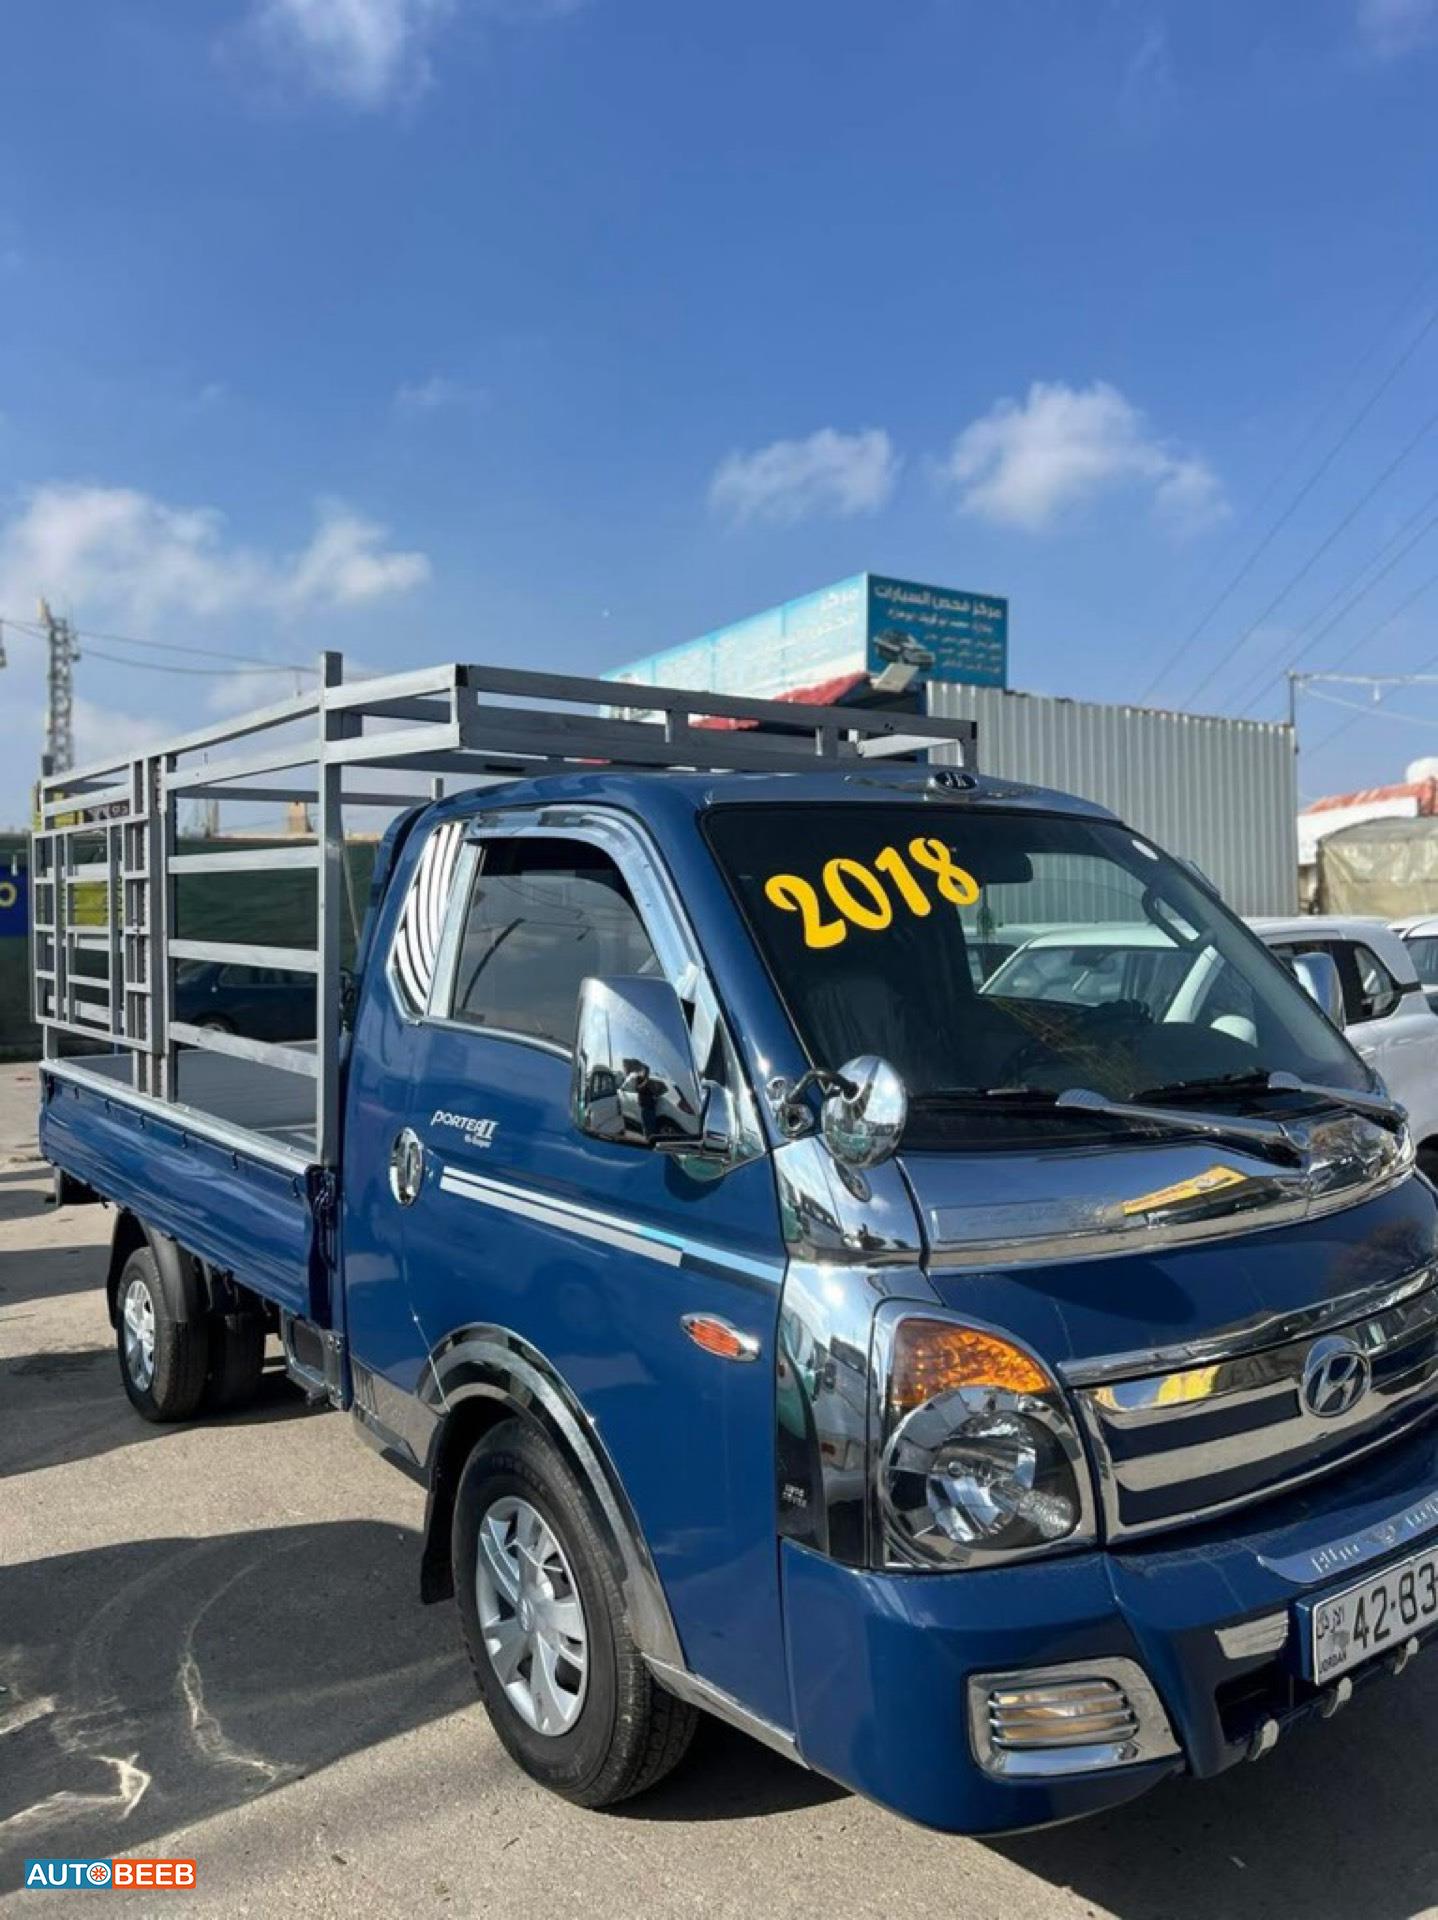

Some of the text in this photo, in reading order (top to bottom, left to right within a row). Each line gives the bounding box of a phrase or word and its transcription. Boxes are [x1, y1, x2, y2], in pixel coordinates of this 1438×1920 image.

[932, 596, 970, 612] فحص
[972, 601, 1002, 618] مركز
[764, 837, 980, 948] 2018
[430, 1110, 482, 1132] PORTER
[1353, 1561, 1438, 1650] 42-83
[1319, 1650, 1347, 1675] JORDAN
